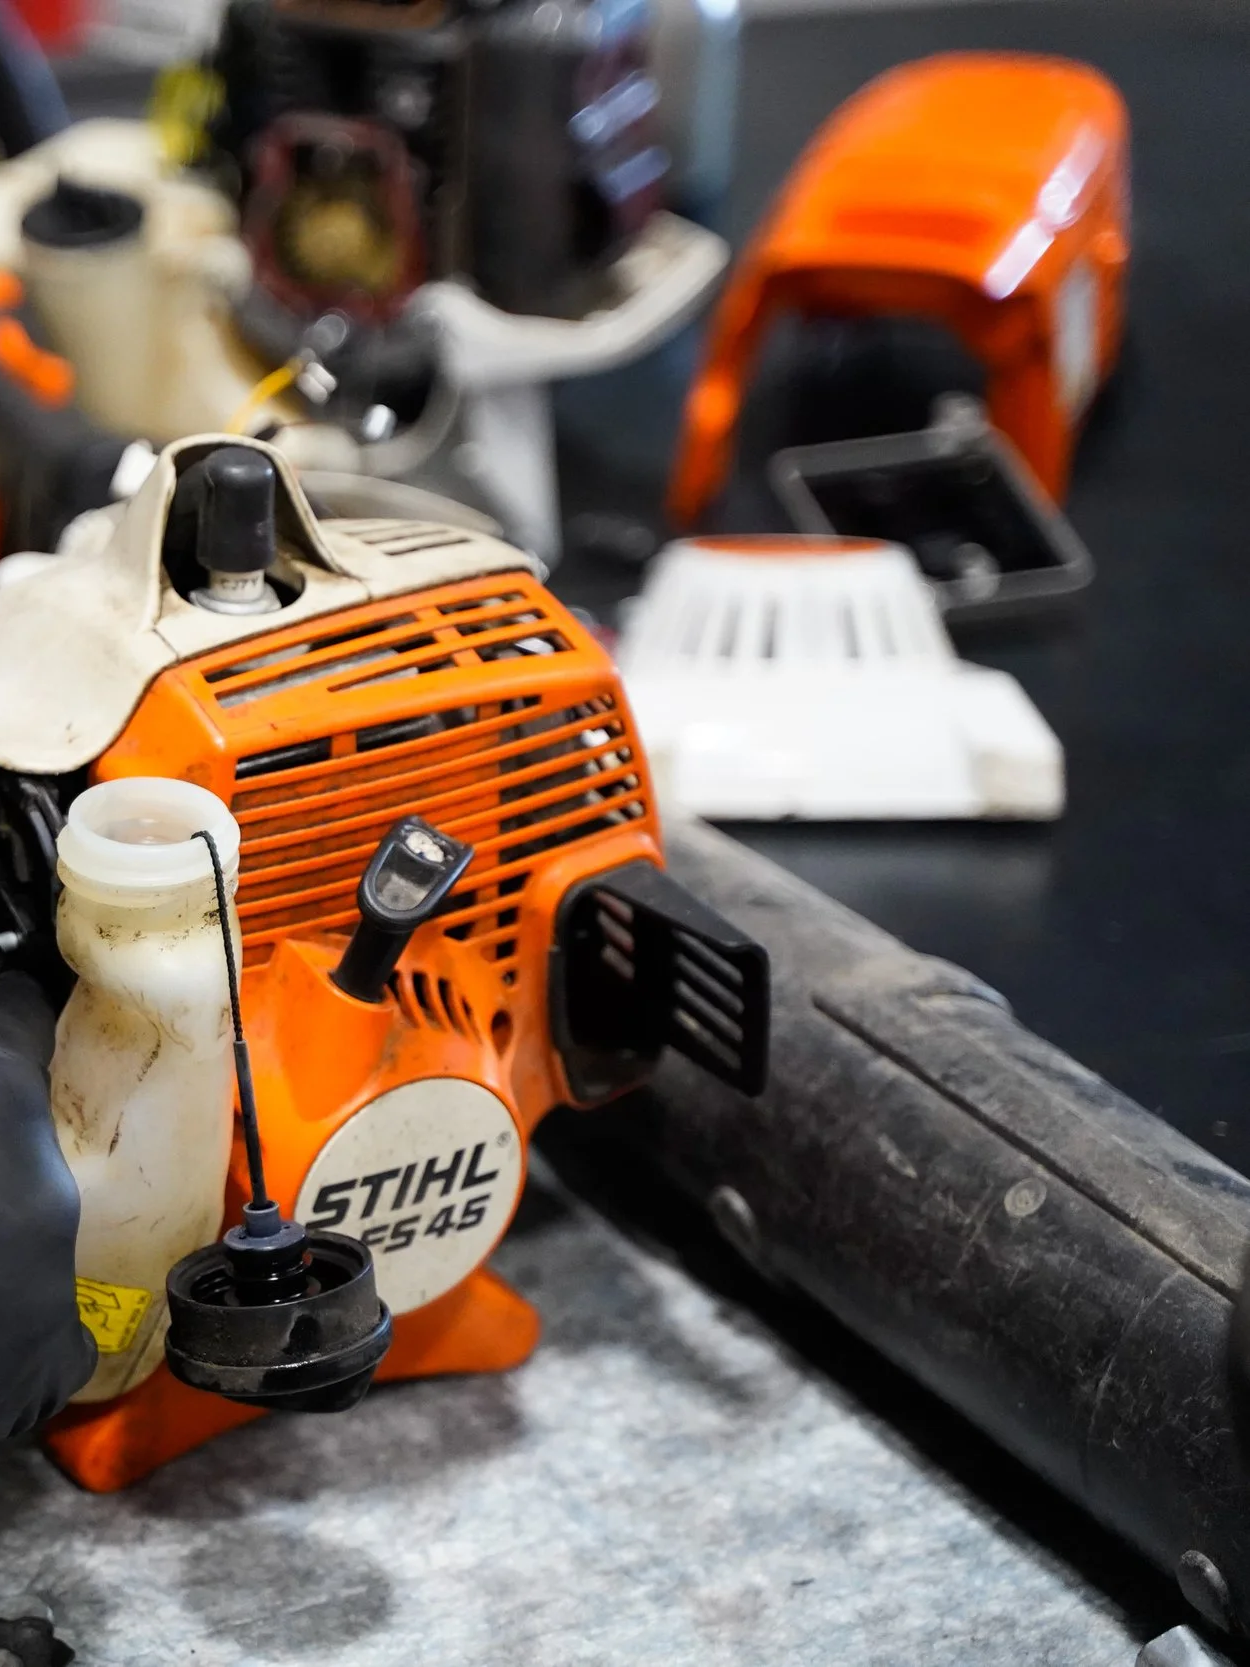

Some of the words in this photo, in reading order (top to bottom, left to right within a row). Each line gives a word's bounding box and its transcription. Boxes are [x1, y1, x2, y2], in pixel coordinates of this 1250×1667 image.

[306, 1142, 499, 1230] STIHL
[361, 1214, 422, 1254] FS
[424, 1193, 493, 1239] 45
